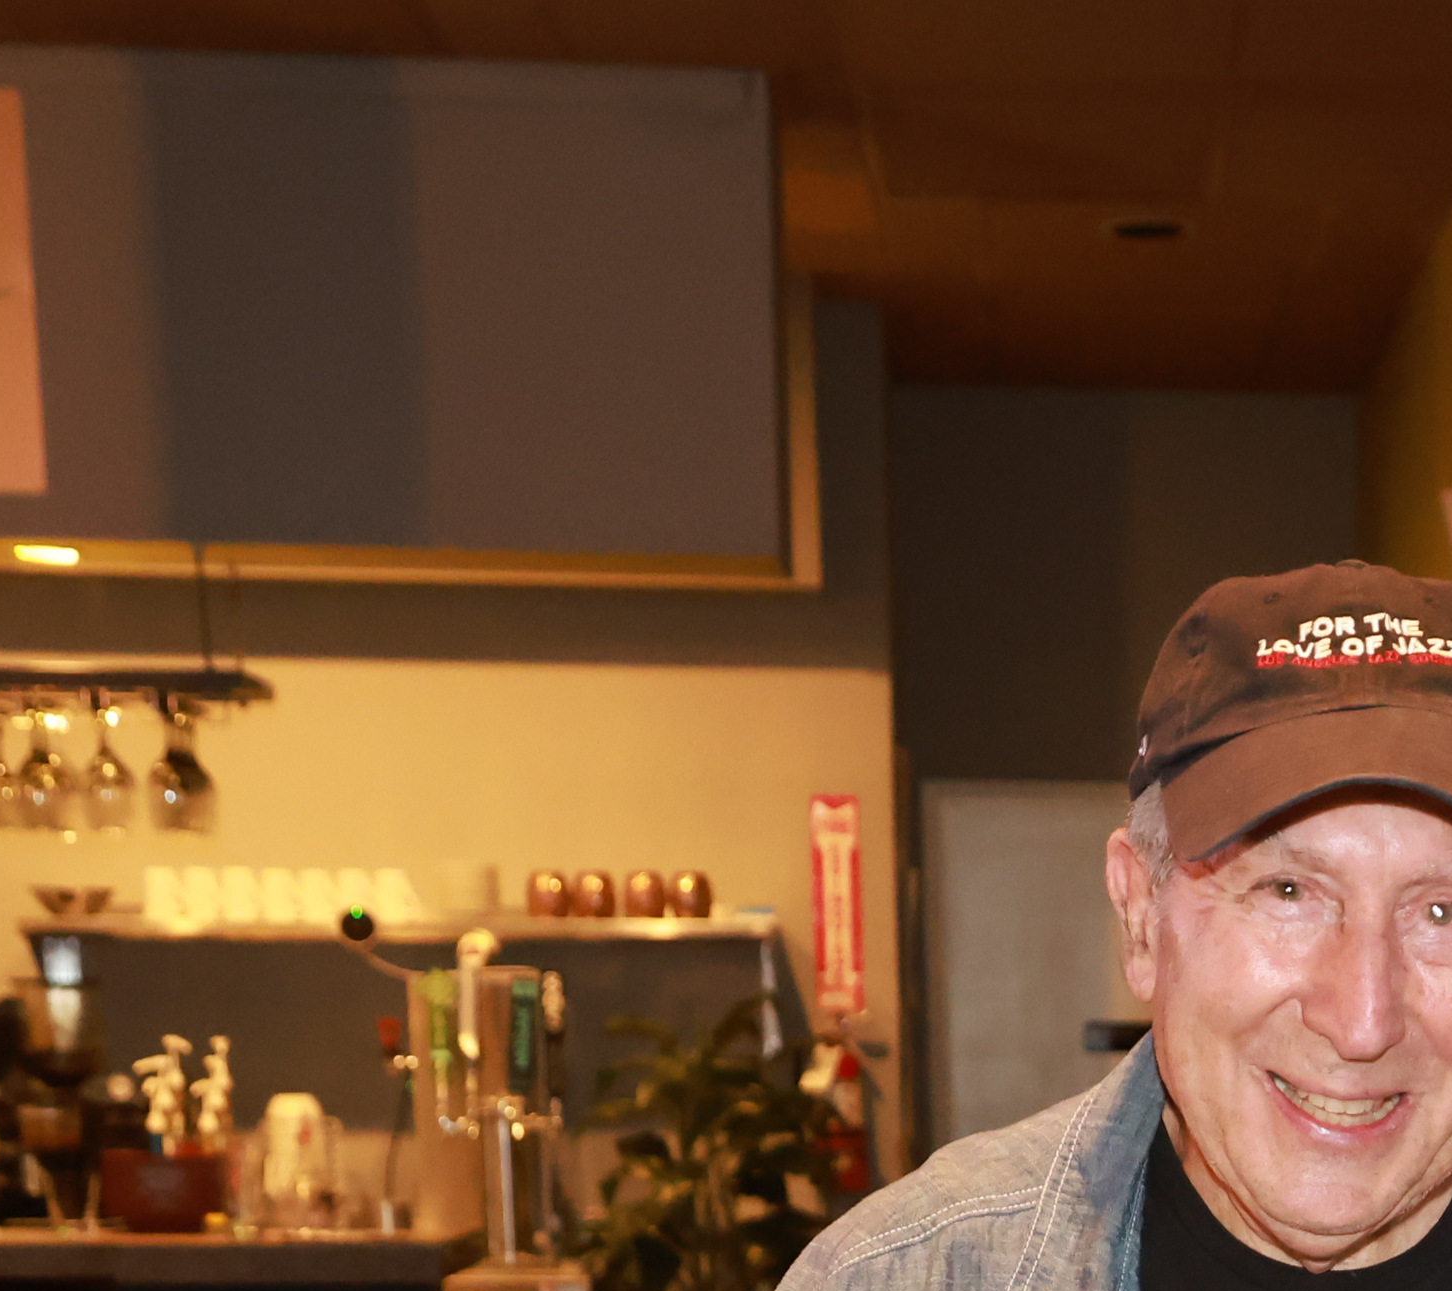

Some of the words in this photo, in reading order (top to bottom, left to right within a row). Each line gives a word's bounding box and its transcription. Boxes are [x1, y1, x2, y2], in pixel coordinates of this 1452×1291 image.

[1299, 616, 1356, 642] FOR
[1363, 612, 1424, 637] THE
[1256, 638, 1332, 659] LOVE
[1341, 635, 1384, 656] OF
